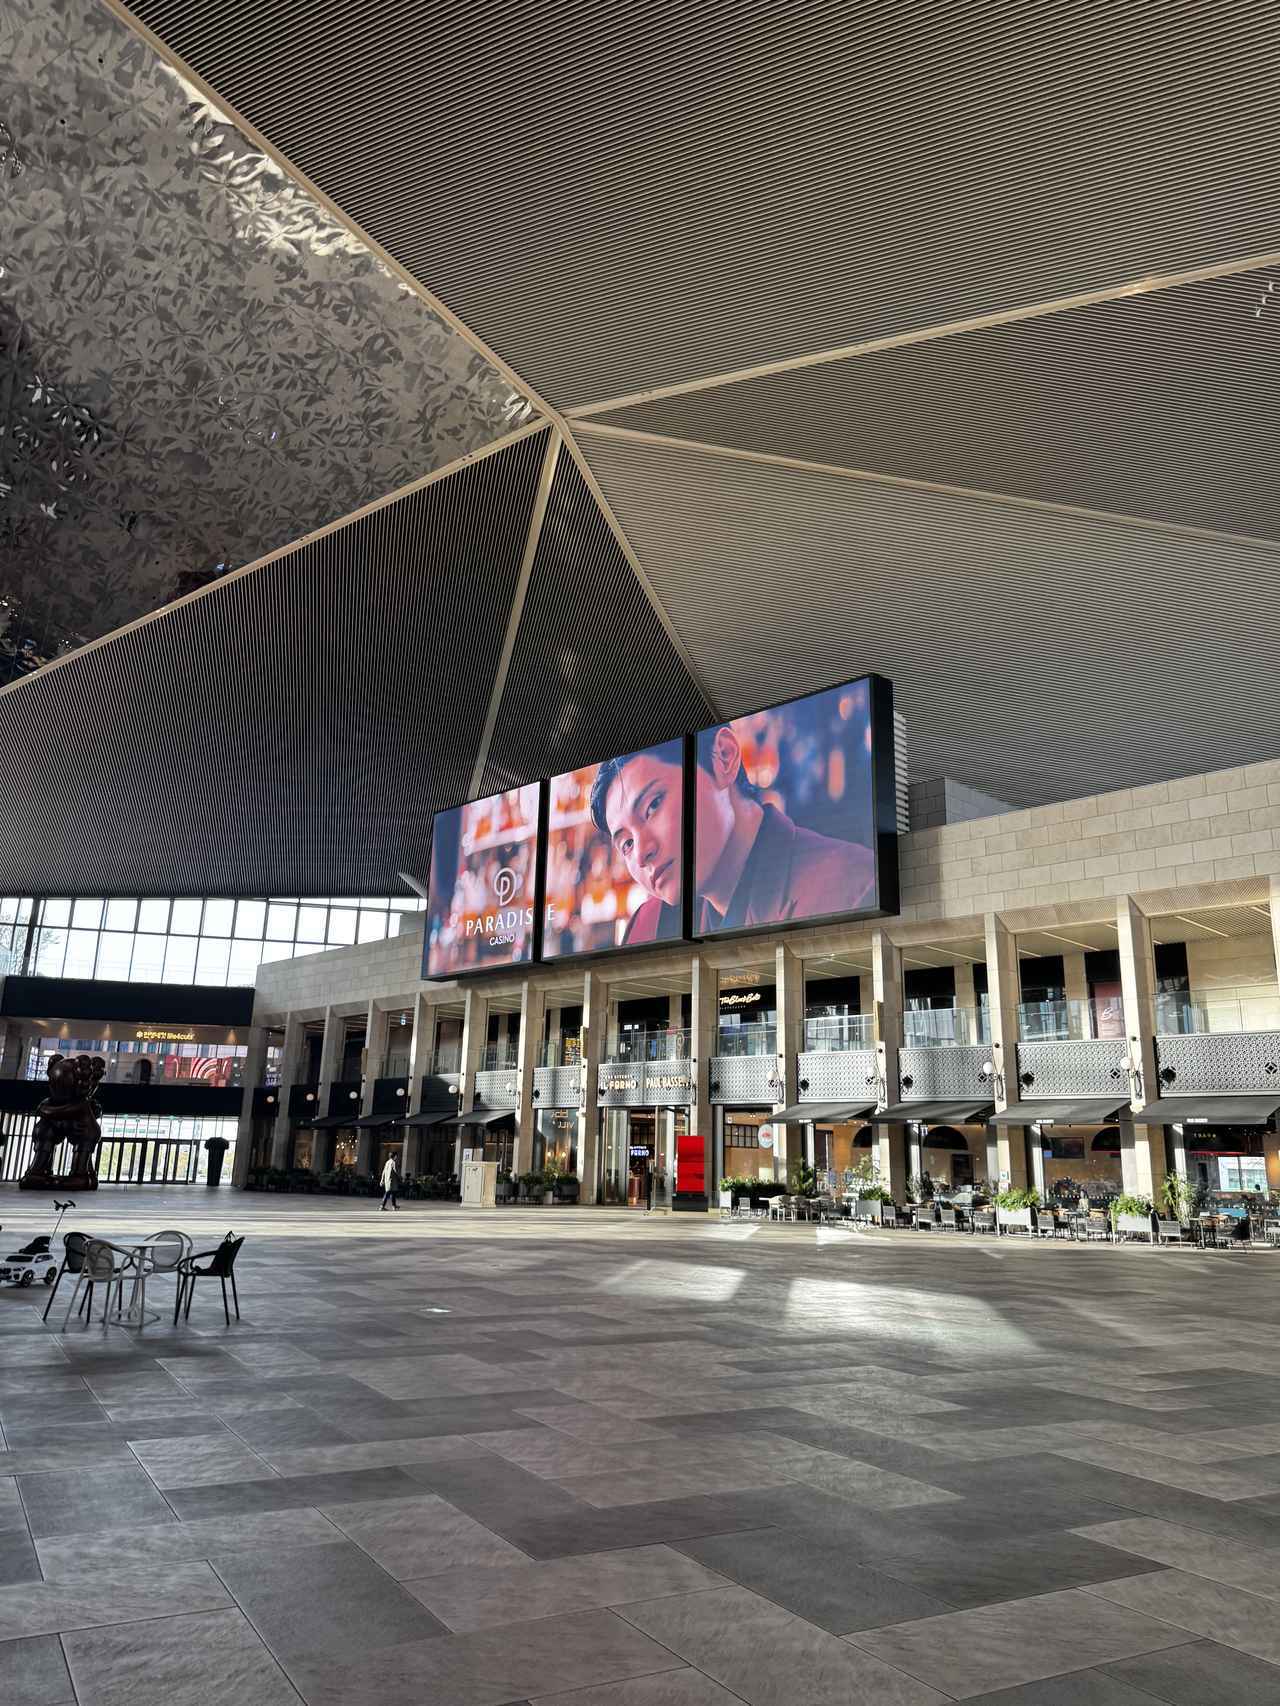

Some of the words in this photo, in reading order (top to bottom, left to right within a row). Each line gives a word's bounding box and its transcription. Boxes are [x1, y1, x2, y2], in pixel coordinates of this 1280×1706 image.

[466, 903, 556, 936] PARADISE
[489, 934, 515, 946] CASINO
[609, 1079, 637, 1090] FORNO
